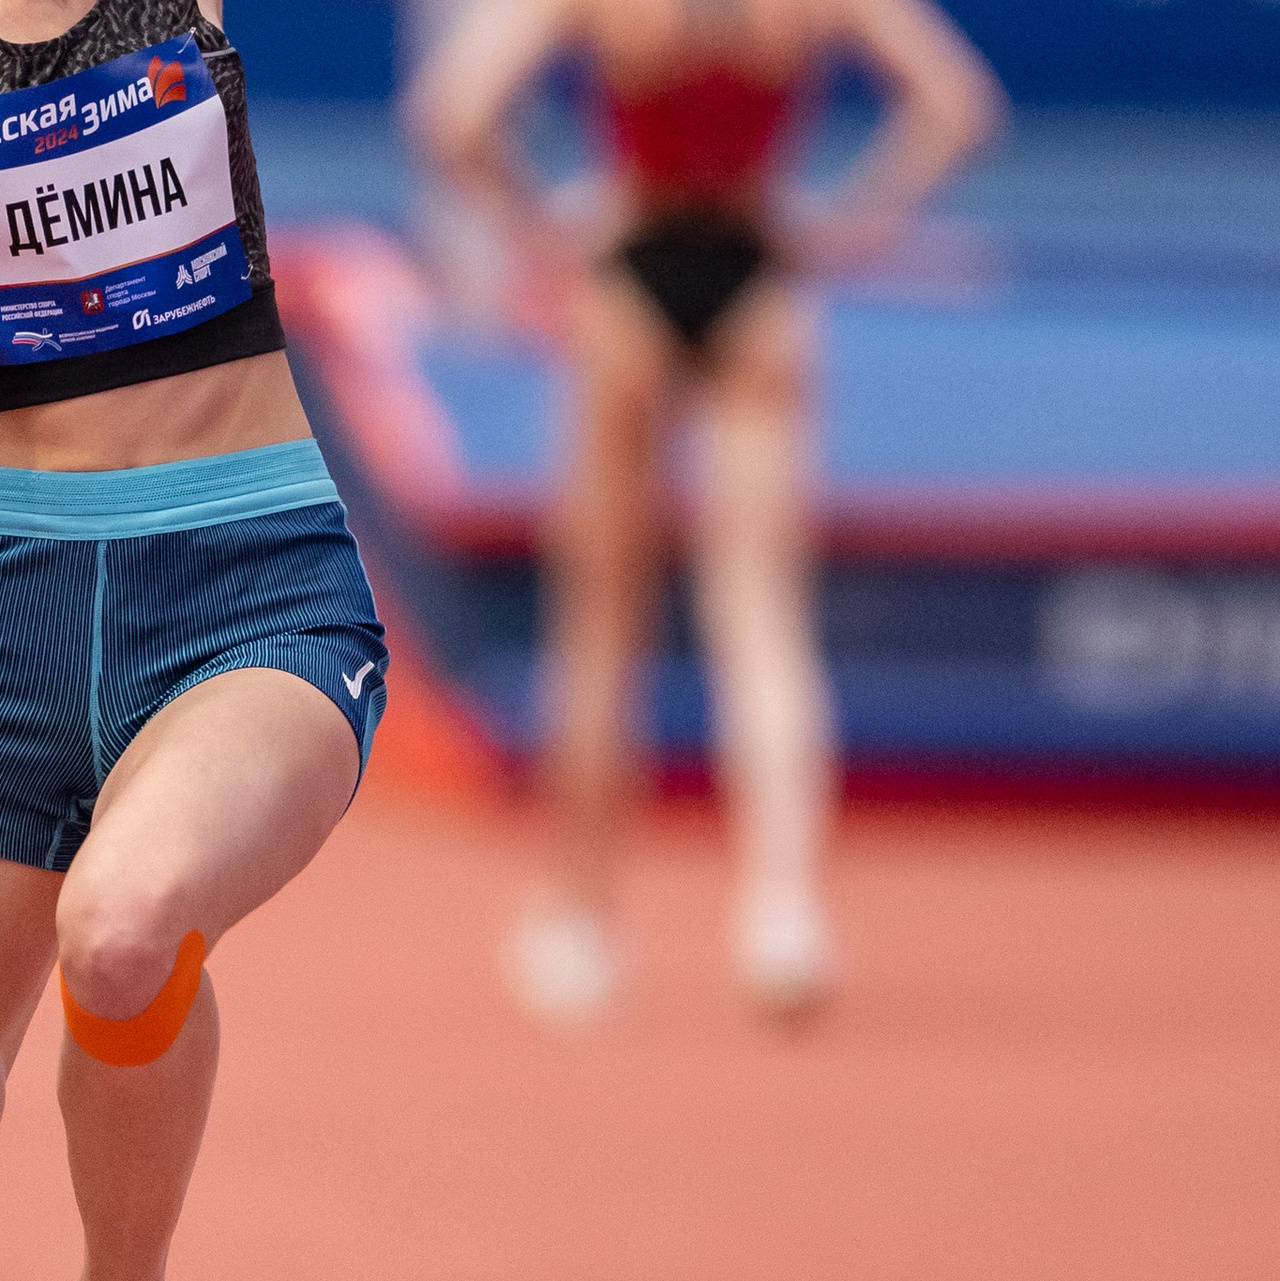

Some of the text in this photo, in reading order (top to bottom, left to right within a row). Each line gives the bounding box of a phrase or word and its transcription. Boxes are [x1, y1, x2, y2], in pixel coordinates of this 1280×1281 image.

[81, 76, 154, 137] Зима
[34, 124, 79, 155] 2024
[5, 156, 188, 257] ДЁМИНА
[153, 294, 216, 325] ЗАРУБЕЖНЕФТЬ
